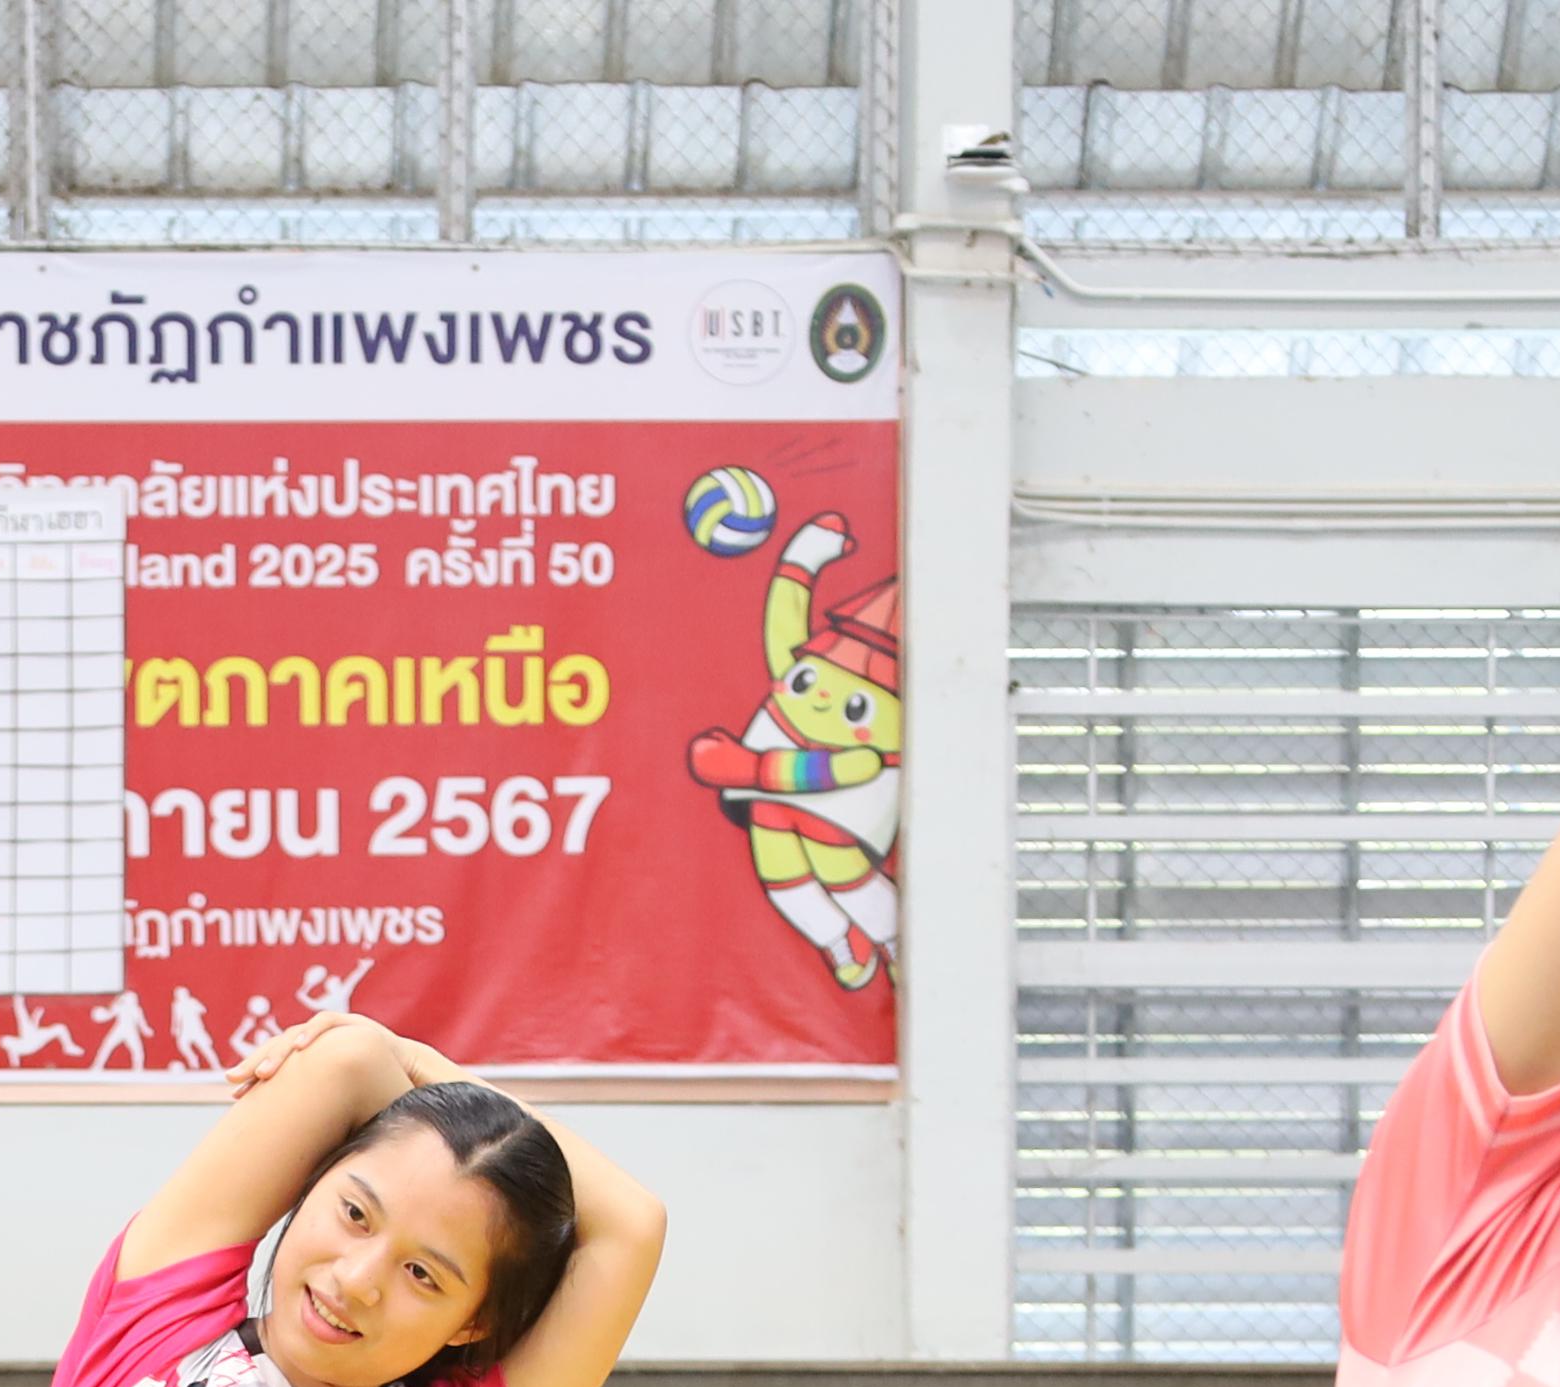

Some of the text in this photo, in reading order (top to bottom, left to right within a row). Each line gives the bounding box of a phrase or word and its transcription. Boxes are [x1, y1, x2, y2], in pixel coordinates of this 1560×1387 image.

[248, 543, 379, 588] 2025
[405, 518, 535, 587] ครั้งที่
[548, 542, 614, 587] 50
[367, 775, 612, 857] 2567
